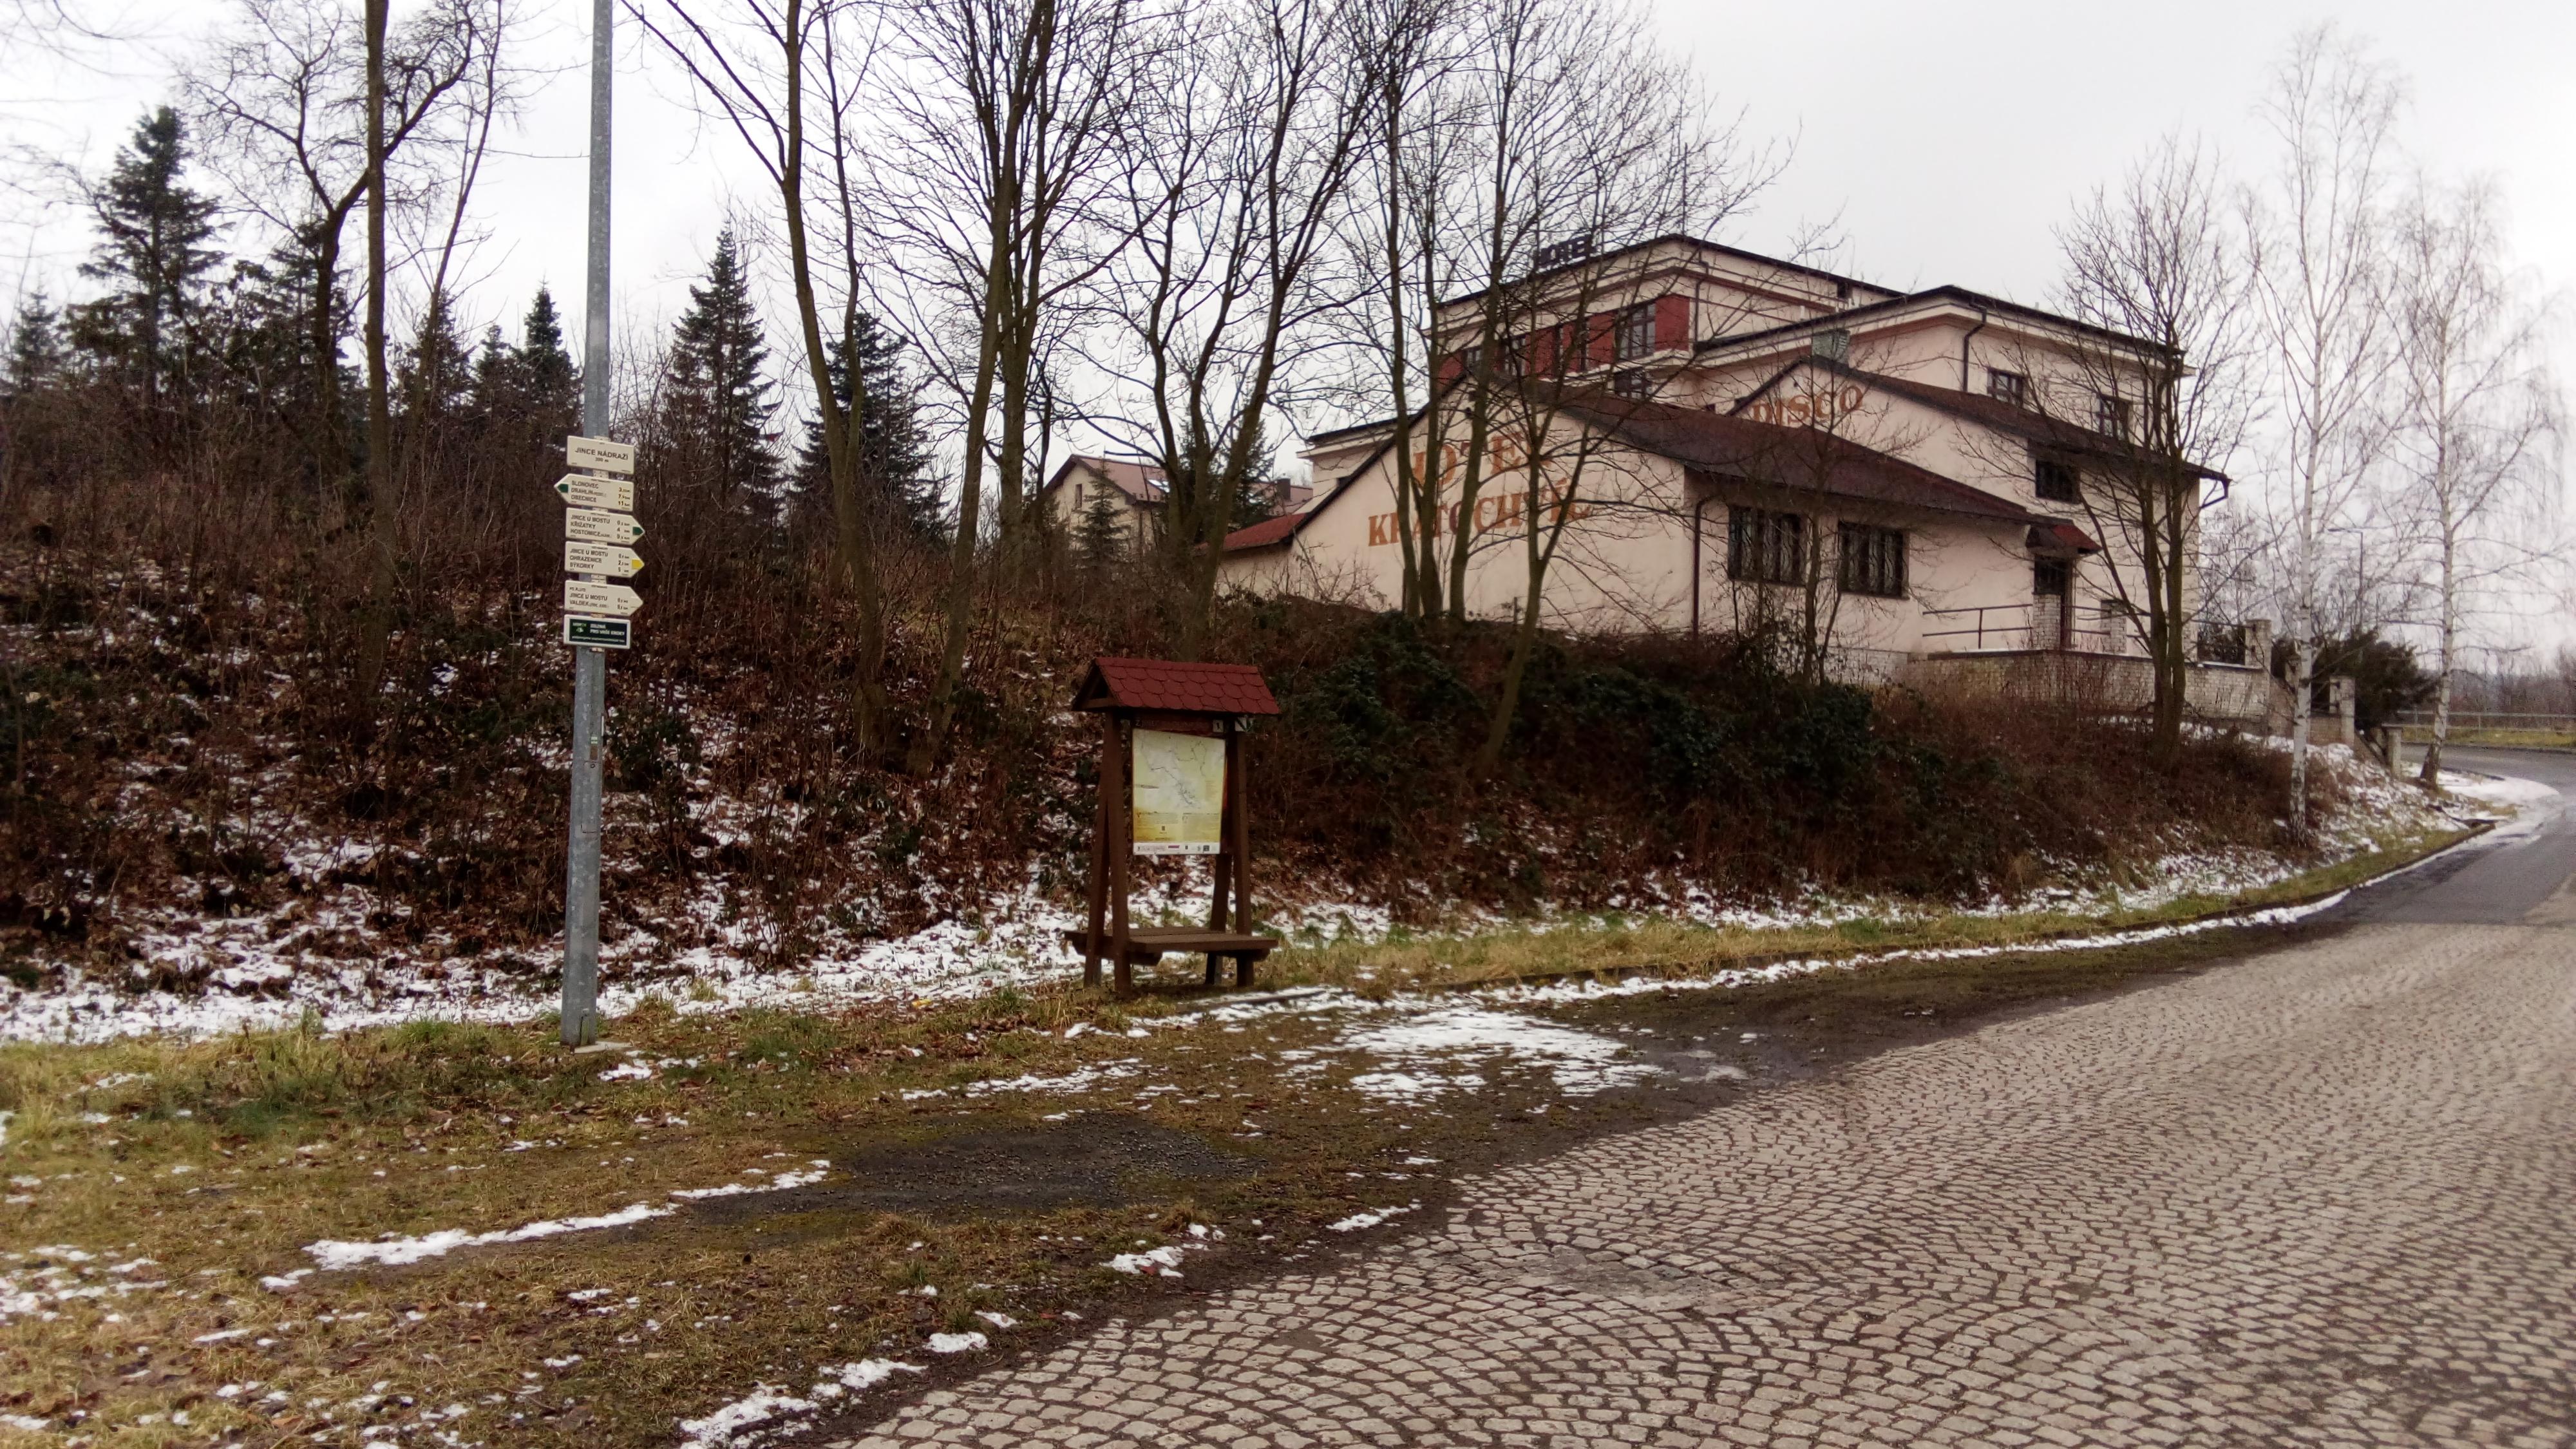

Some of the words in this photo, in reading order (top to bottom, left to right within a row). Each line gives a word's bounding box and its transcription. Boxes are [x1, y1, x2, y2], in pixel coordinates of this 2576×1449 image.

[1751, 386, 1863, 426] DISCO
[598, 450, 629, 460] NÁDRAŽÍ
[1368, 477, 1590, 547] KTOCHVÍL
